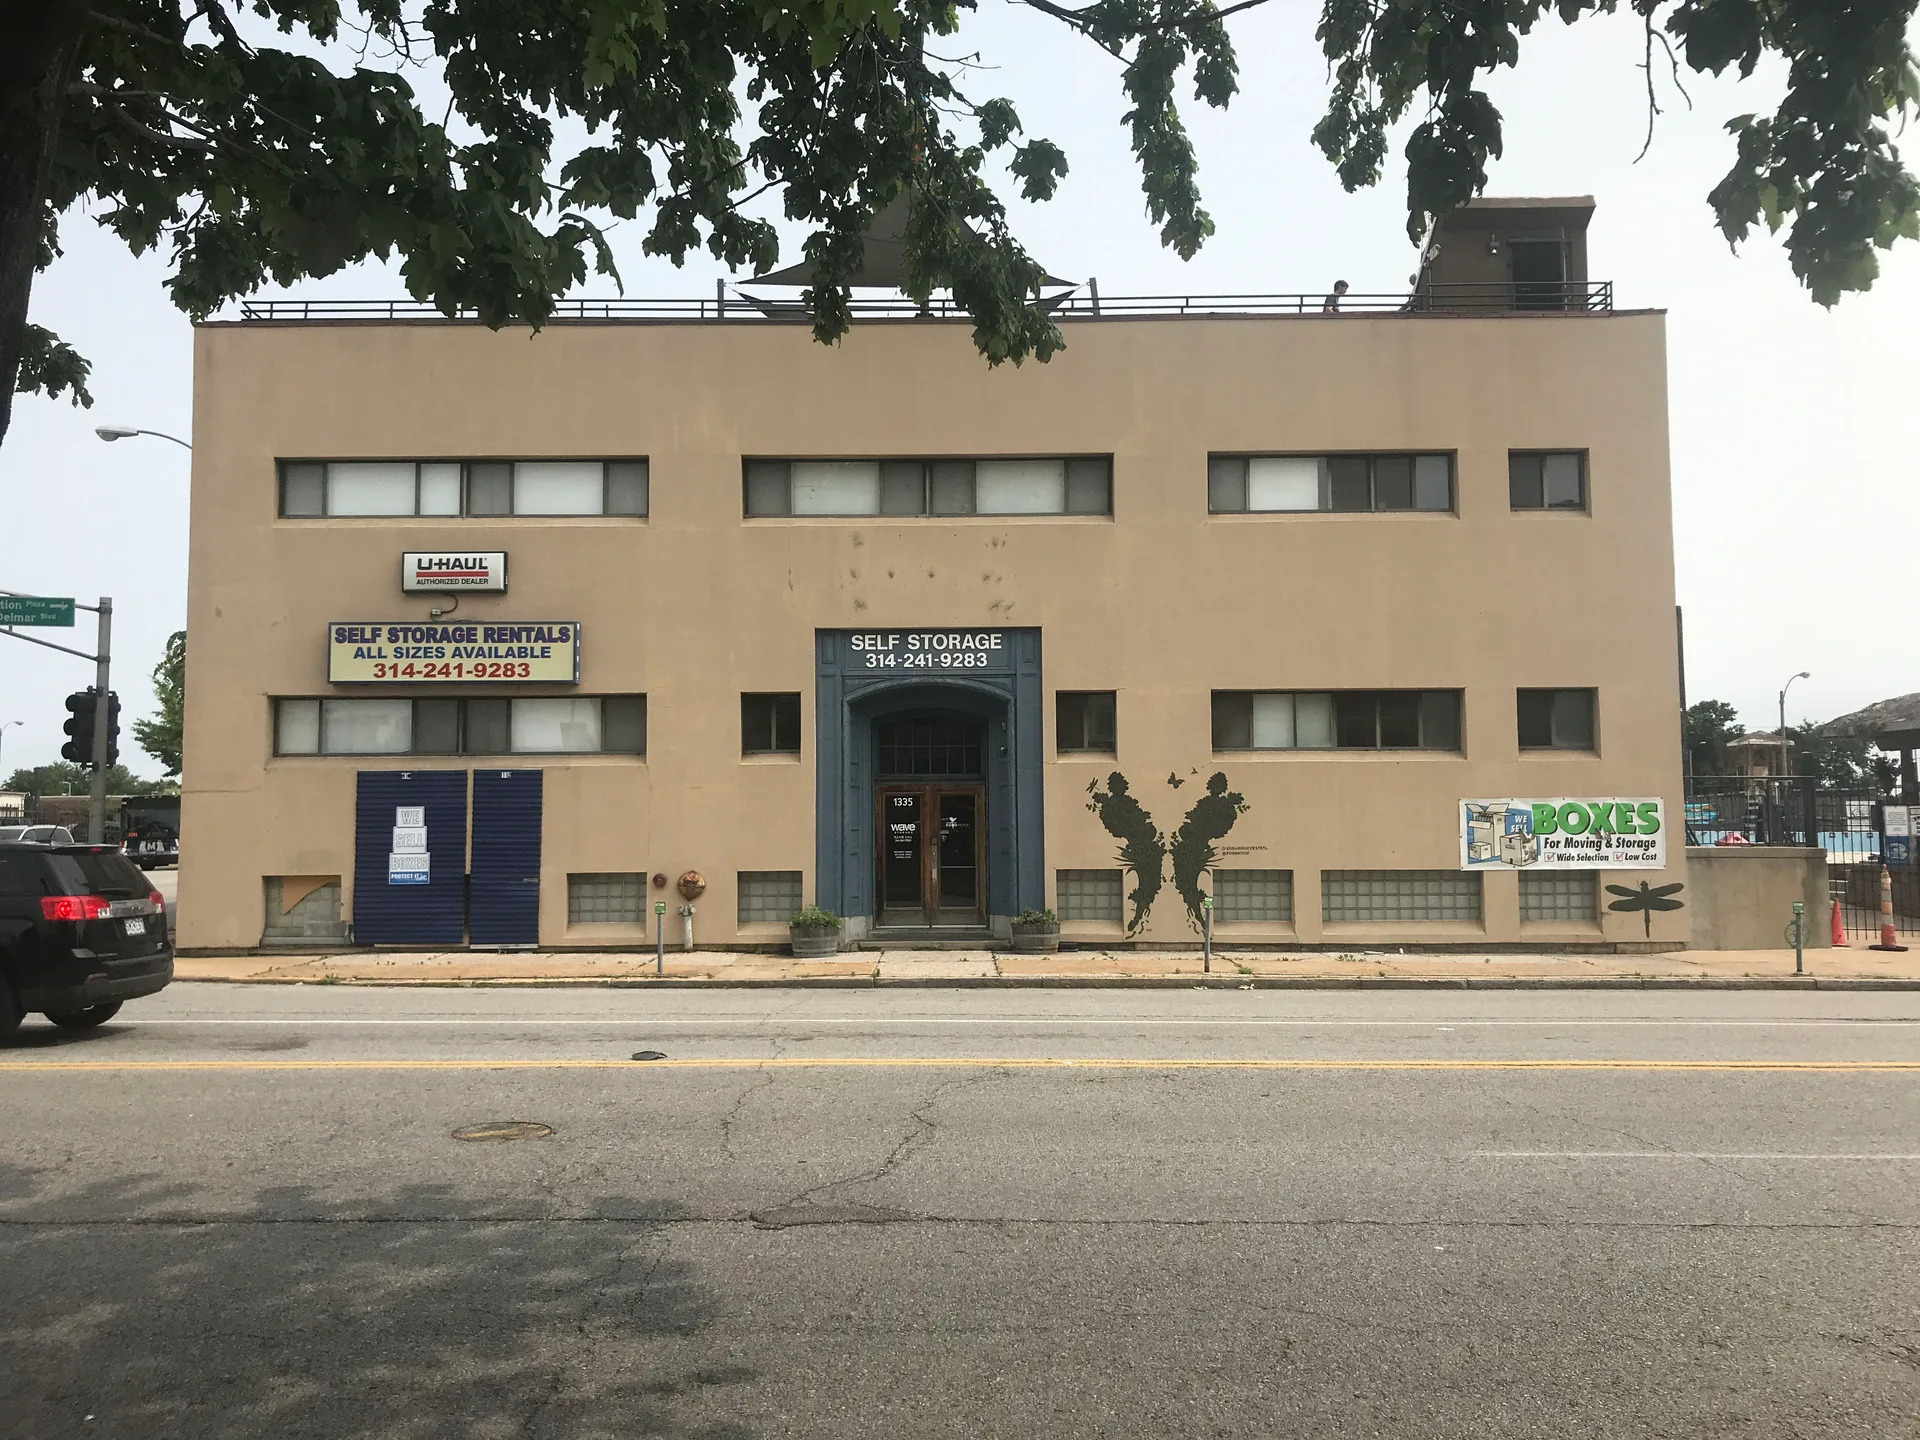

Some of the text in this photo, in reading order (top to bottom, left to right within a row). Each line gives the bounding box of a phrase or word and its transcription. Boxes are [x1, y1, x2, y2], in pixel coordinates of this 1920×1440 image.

[417, 558, 488, 570] U-HAUL
[334, 626, 571, 643] SELF STORAGE RENTALS
[851, 633, 1002, 650] SELF STORAGE
[353, 646, 551, 659] ALL SIZES AVAILABLE
[866, 653, 988, 668] 314-241-9283
[373, 662, 531, 678] 314-241-9283
[893, 797, 913, 807] 1335
[401, 810, 419, 824] WE
[1515, 815, 1528, 823] WE
[1531, 802, 1660, 835] BOXES
[890, 823, 916, 831] wave
[395, 834, 424, 847] SELL
[1544, 837, 1656, 851] For Moving & Storage
[391, 857, 428, 870] BOXES
[1557, 852, 1657, 862] Wide Selection Low Cost
